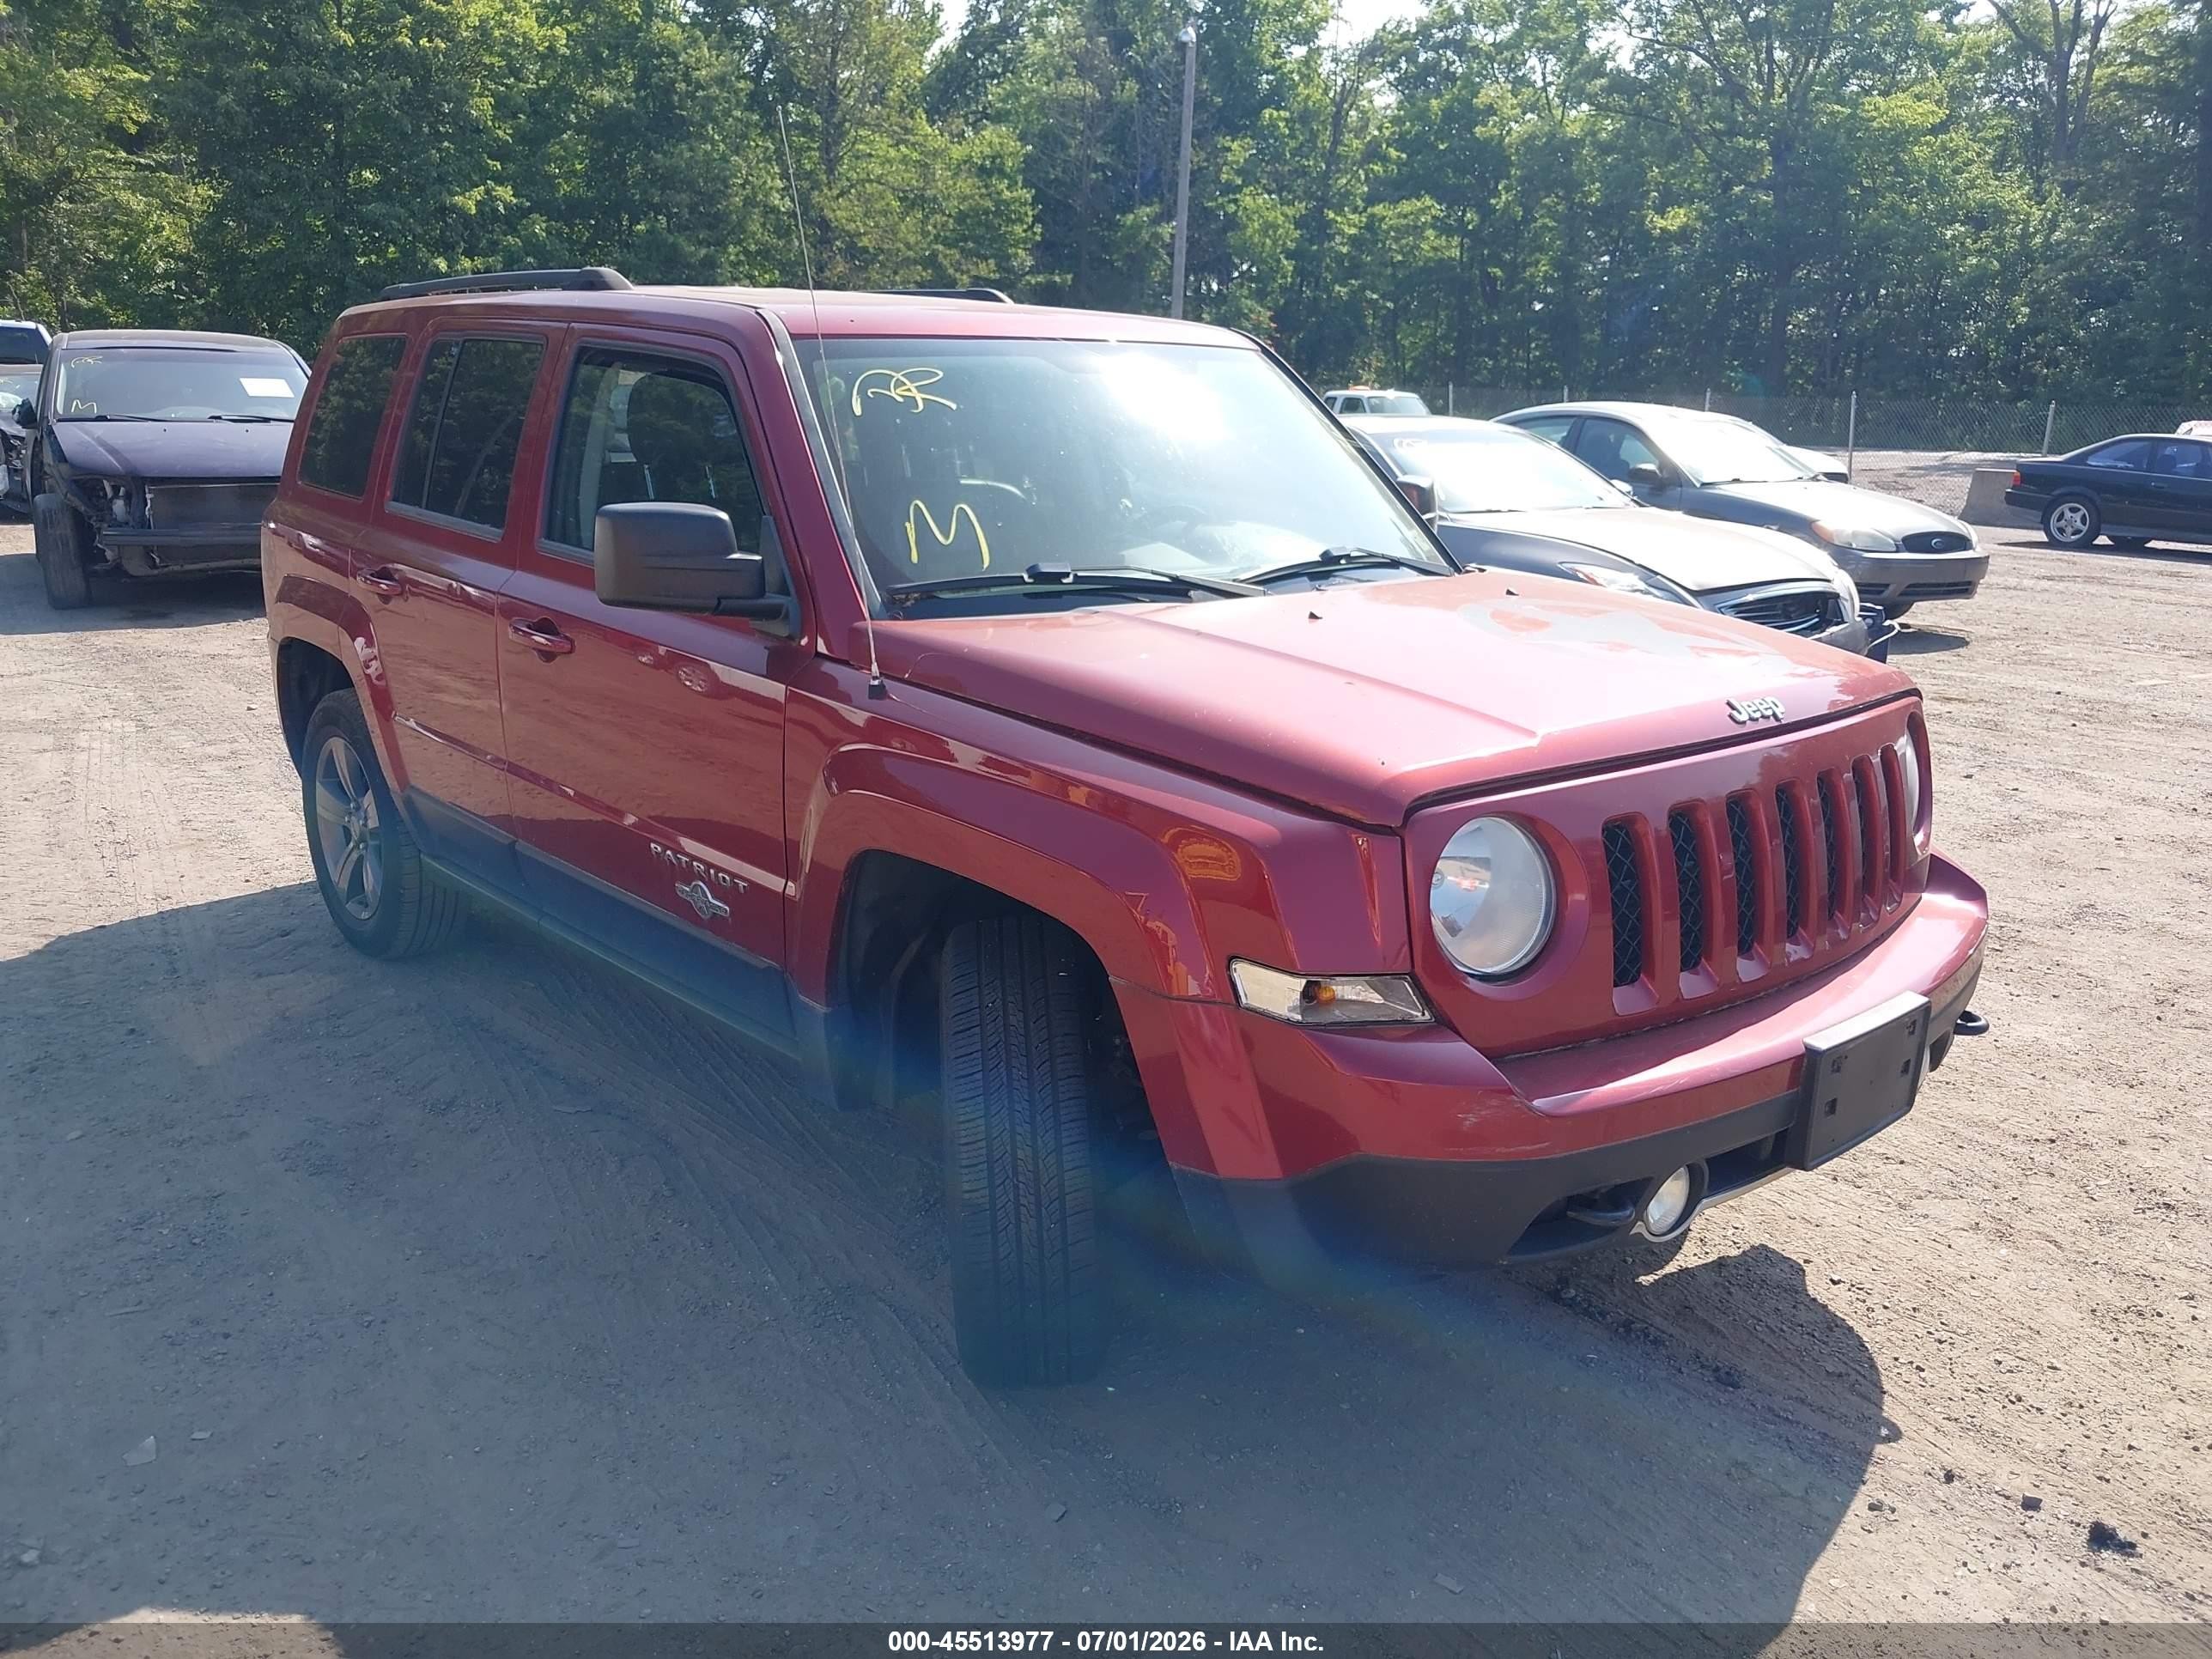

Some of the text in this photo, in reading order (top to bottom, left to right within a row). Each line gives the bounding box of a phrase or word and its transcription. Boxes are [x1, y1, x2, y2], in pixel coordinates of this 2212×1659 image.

[905, 499, 990, 571] M
[1724, 696, 1786, 726] Jeep
[650, 842, 749, 894] PATRIOT
